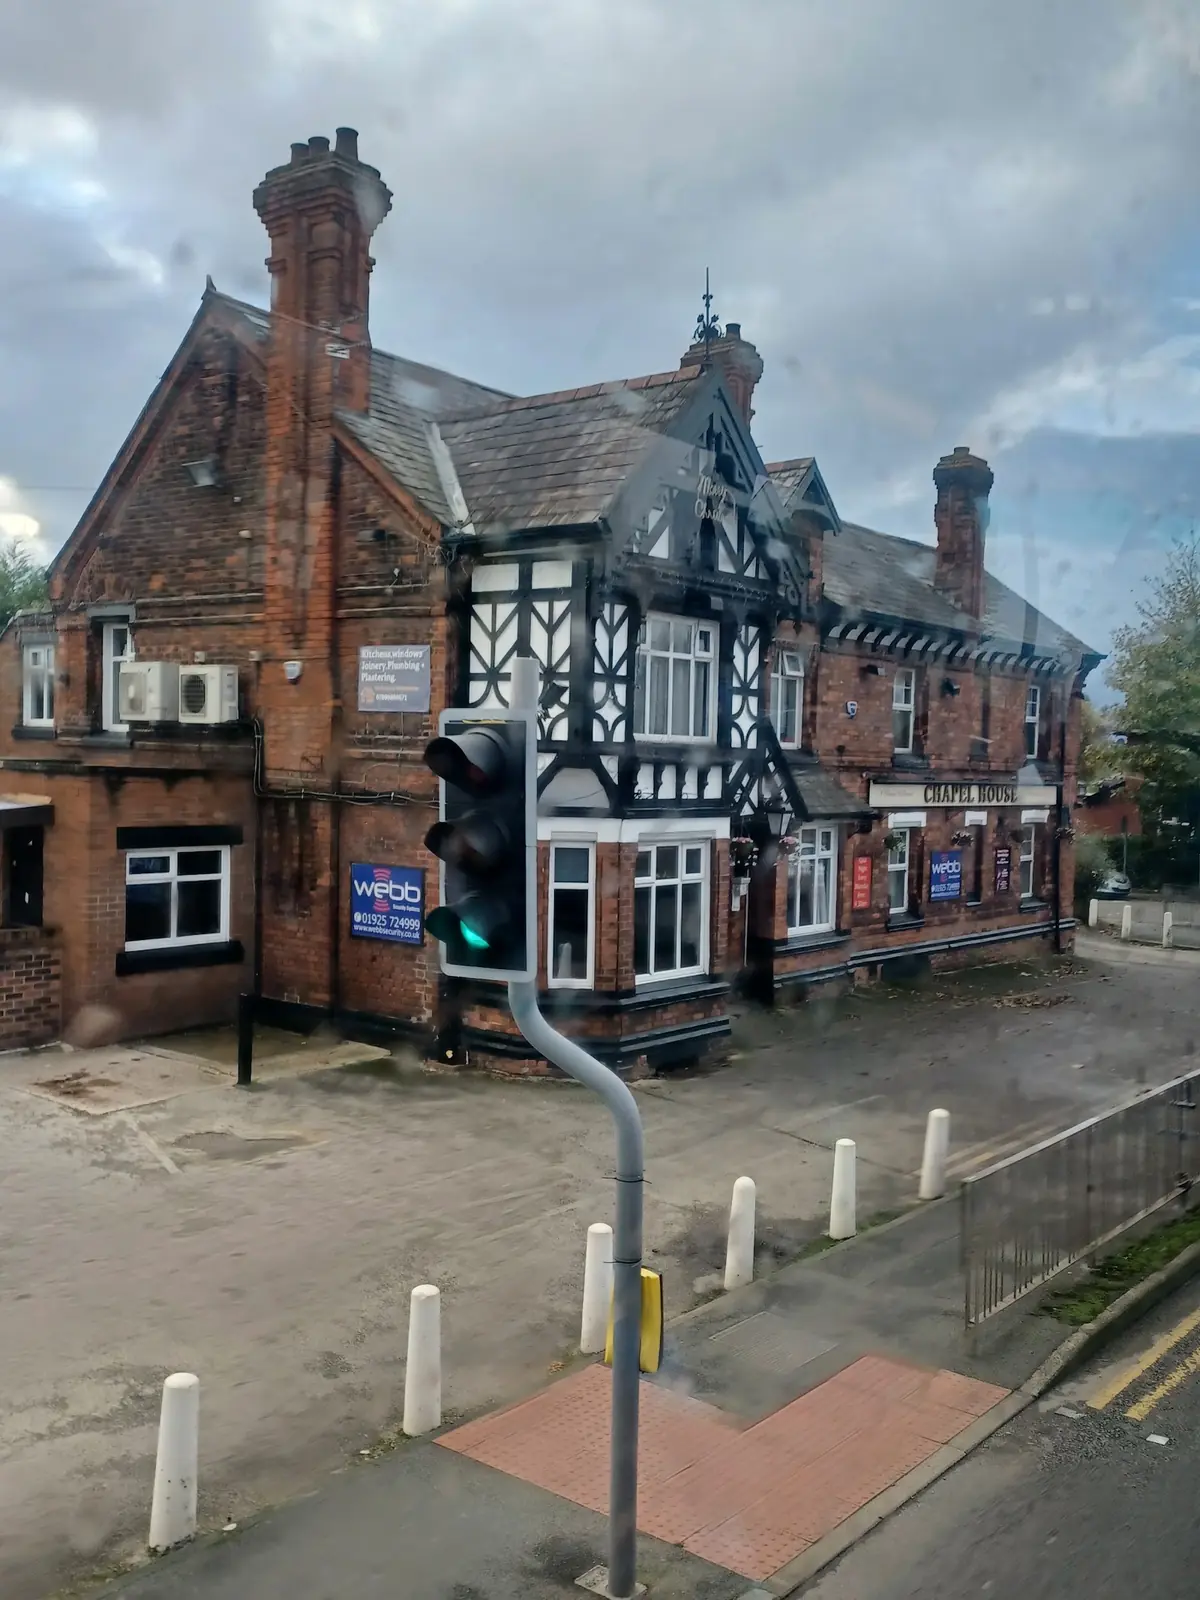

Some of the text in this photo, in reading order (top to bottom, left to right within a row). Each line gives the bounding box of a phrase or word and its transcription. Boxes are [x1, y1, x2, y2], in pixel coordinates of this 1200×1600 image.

[923, 784, 975, 804] CHAPEL
[977, 785, 1019, 804] HOUSE
[932, 860, 961, 874] webb
[354, 880, 421, 903] webb
[362, 912, 421, 931] 01925 724999
[353, 924, 420, 939] www.webbsecurity.co.uk
